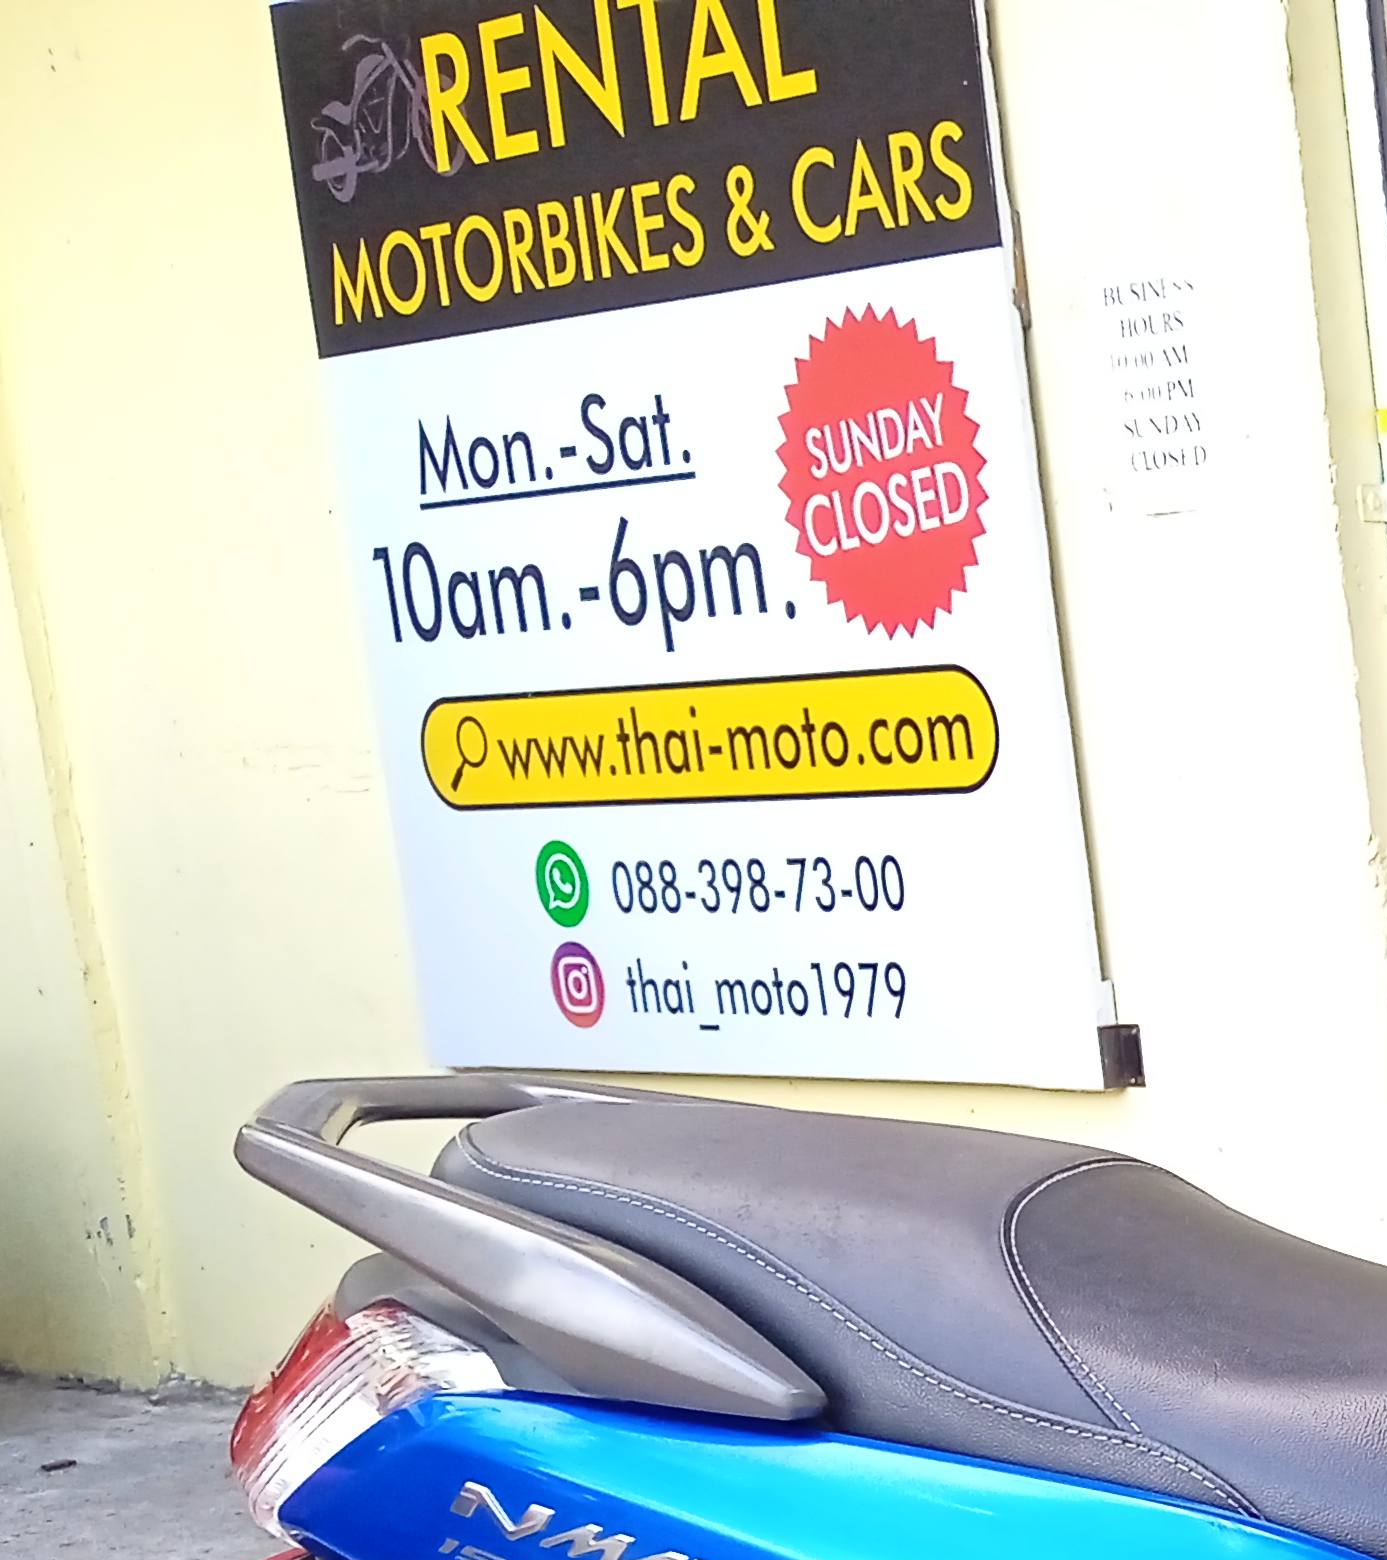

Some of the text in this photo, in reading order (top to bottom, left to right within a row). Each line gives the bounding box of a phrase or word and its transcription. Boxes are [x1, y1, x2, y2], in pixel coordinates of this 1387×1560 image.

[420, 0, 818, 173] RENTAL
[332, 120, 973, 325] MOTORBIKES & CARS
[1121, 311, 1184, 338] HOURS
[1124, 412, 1201, 438] SUNDAY
[1167, 378, 1194, 401] PM
[418, 393, 692, 496] Mon.-Sat.
[806, 392, 944, 478] SUNDAY
[1131, 446, 1207, 472] CLOSED
[804, 461, 969, 556] CLOSED
[373, 516, 797, 652] 10am.-6pm.
[497, 706, 974, 780] www.thai-moto.com
[612, 855, 905, 914] 088-398-73-00
[626, 957, 906, 1031] thai_moto1979
